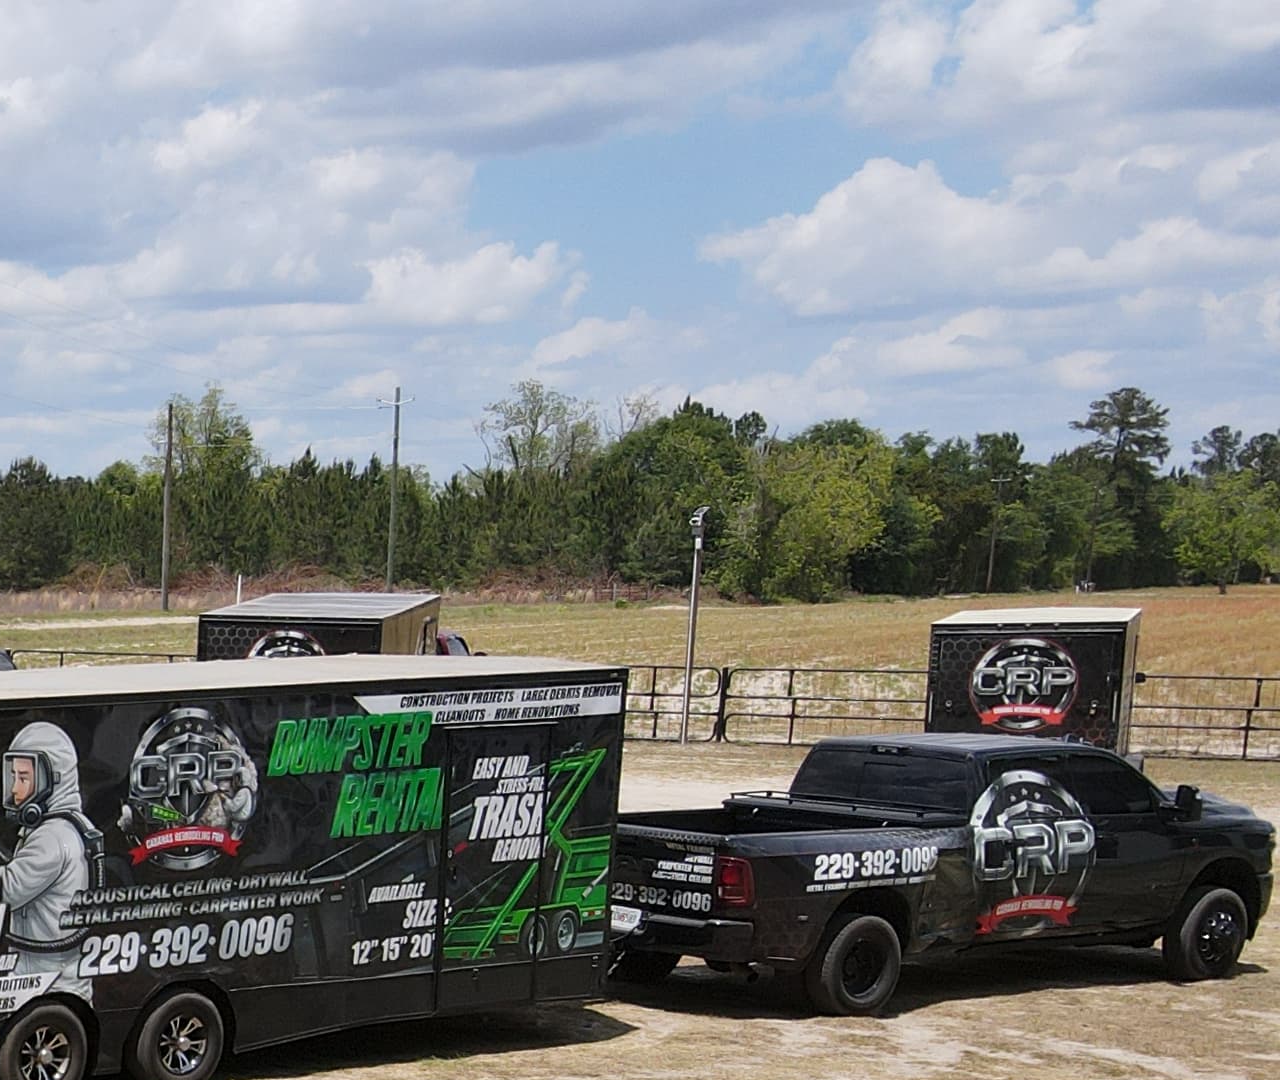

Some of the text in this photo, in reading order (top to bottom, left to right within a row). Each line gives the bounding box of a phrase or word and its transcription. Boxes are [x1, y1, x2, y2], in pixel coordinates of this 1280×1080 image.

[973, 667, 1076, 695] CRP
[400, 692, 471, 709] CONSTRUCTION
[471, 690, 514, 705] PROJECTS
[435, 709, 486, 722] CLEANOUTS
[521, 703, 580, 719] RENOVATIONS
[267, 711, 433, 777] DUMPSTER
[129, 750, 242, 798] CRP
[472, 755, 530, 780] EASY AND
[496, 776, 545, 794] STRESS-FRE
[973, 819, 1096, 882] CRP
[71, 870, 309, 907] ACOUSTICAL CEILING DRYWALL
[190, 893, 277, 915] CARPENTER
[280, 888, 325, 907] WORK
[368, 882, 426, 904] AVAILABLE
